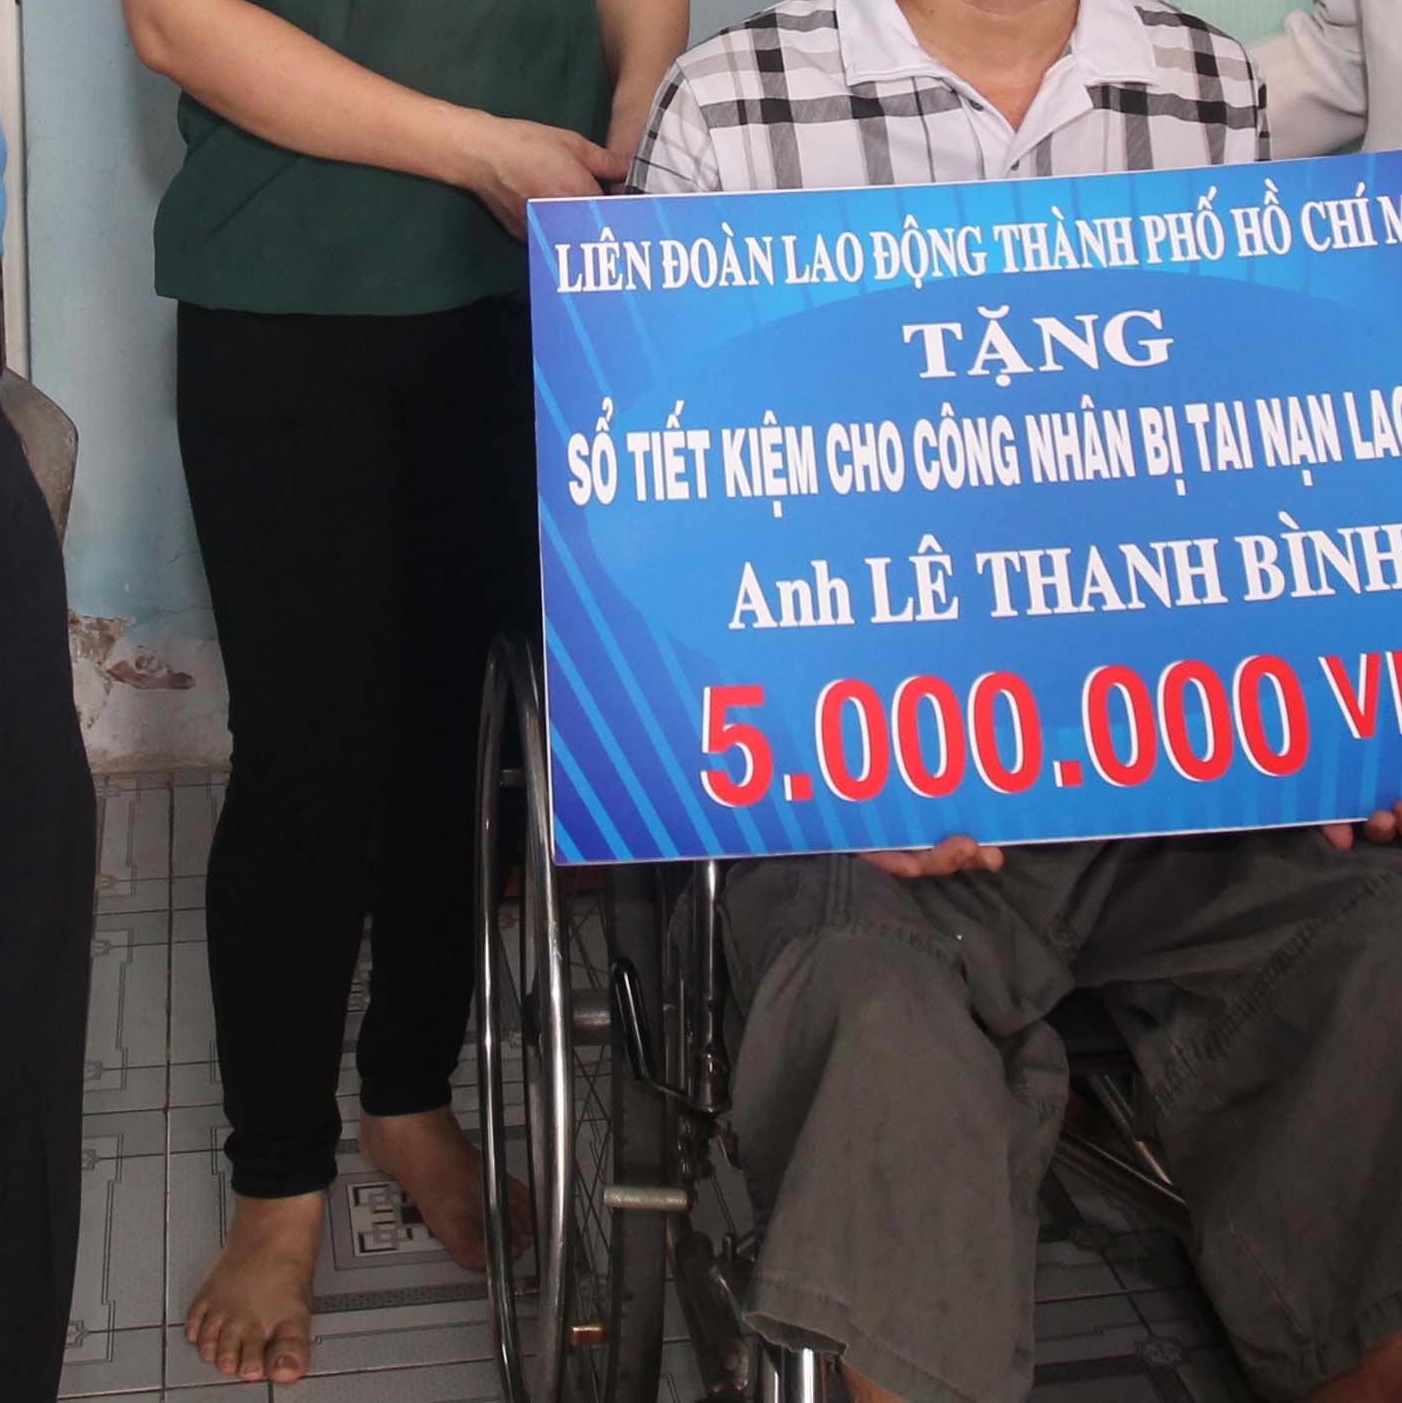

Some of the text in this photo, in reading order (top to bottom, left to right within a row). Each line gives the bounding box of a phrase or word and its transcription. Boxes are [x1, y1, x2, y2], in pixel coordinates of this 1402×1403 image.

[555, 224, 653, 294] LIÊN
[659, 218, 776, 290] ĐOÀN
[781, 231, 866, 285] LAO
[870, 212, 988, 290] ĐỘNG
[993, 203, 1137, 275] THÀNH
[1140, 177, 1226, 266] PHỐ
[1231, 177, 1293, 258] HỒ
[1301, 180, 1377, 252] CHÍ
[902, 303, 1174, 389] TẶNG
[567, 394, 618, 506] SỔ
[626, 396, 712, 502] TIẾT
[721, 408, 819, 519] KIỆM
[825, 420, 905, 494] CHO
[913, 401, 1021, 491] CÔNG
[1026, 393, 1134, 484] NHÂN
[1140, 405, 1188, 497] BỊ
[1187, 401, 1255, 472] TAI
[1257, 394, 1344, 488] NẠN
[728, 557, 855, 630] Anh
[865, 532, 959, 625] LÊ
[975, 537, 1228, 617] THANH
[700, 654, 1311, 809] 5.000.000
